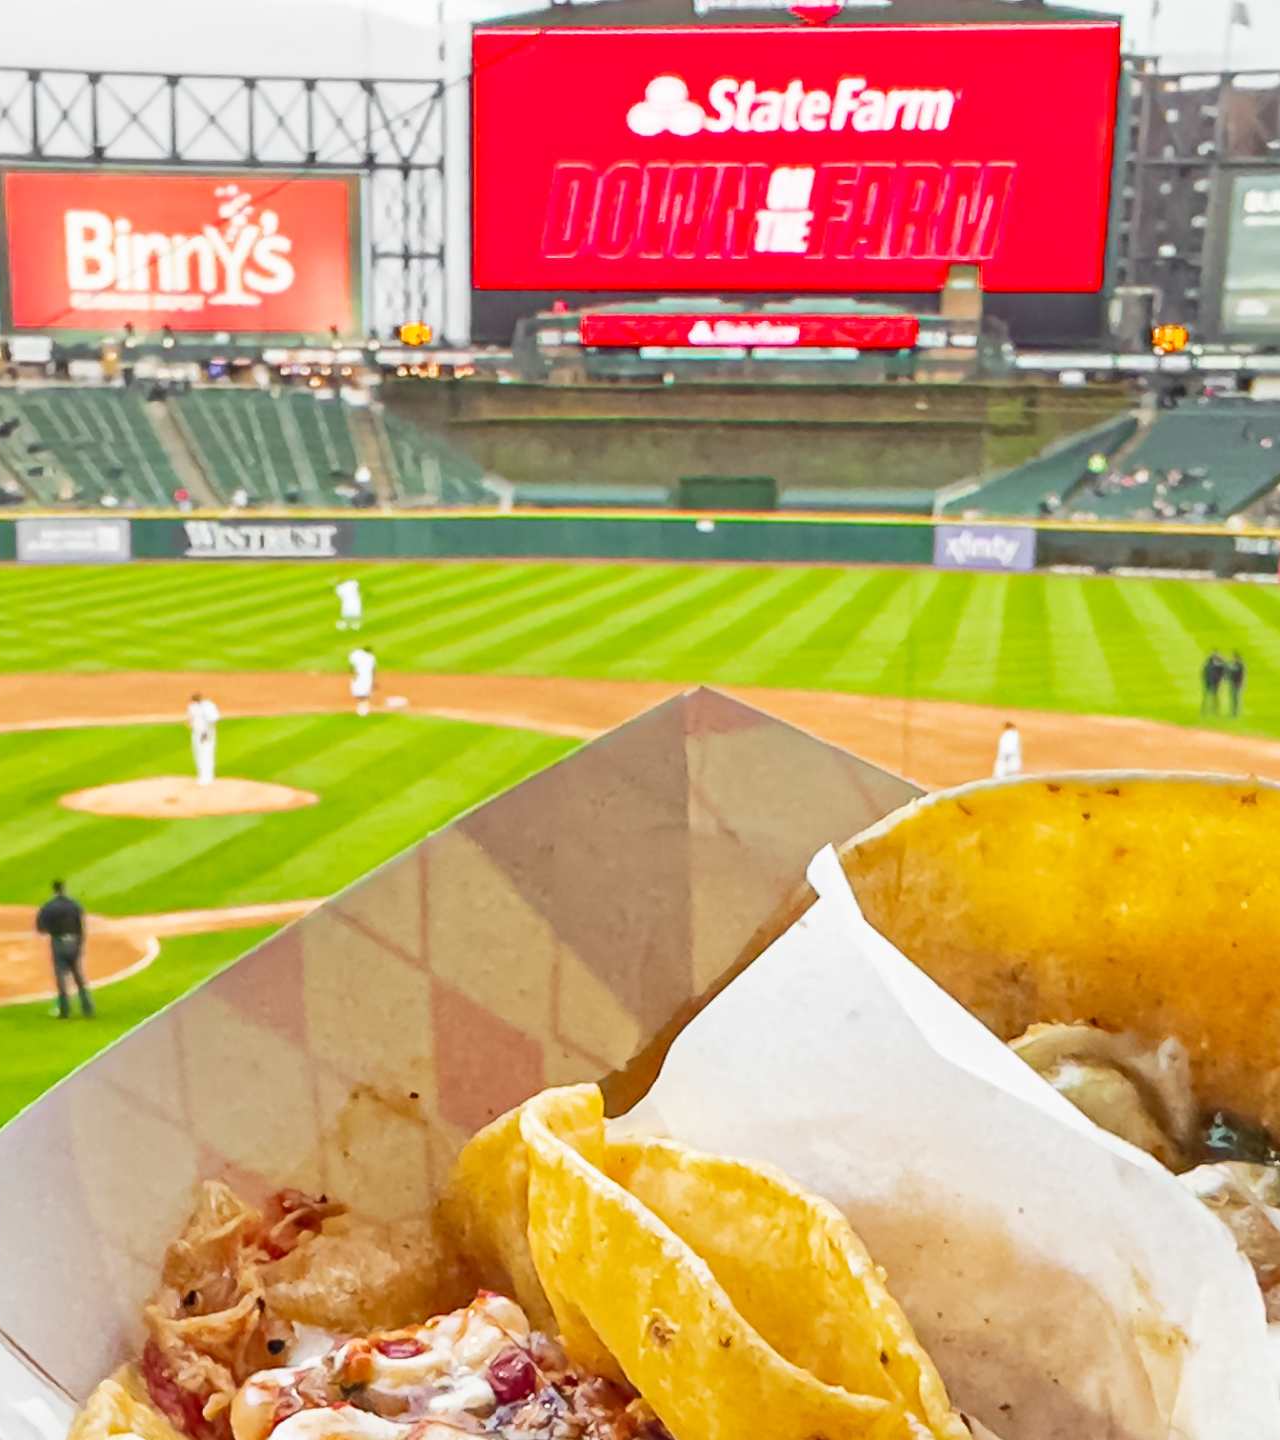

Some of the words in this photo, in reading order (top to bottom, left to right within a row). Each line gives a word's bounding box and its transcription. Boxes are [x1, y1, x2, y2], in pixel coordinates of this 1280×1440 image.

[65, 209, 296, 306] Binny's
[540, 162, 769, 259] DOWN
[804, 162, 1018, 260] FARM
